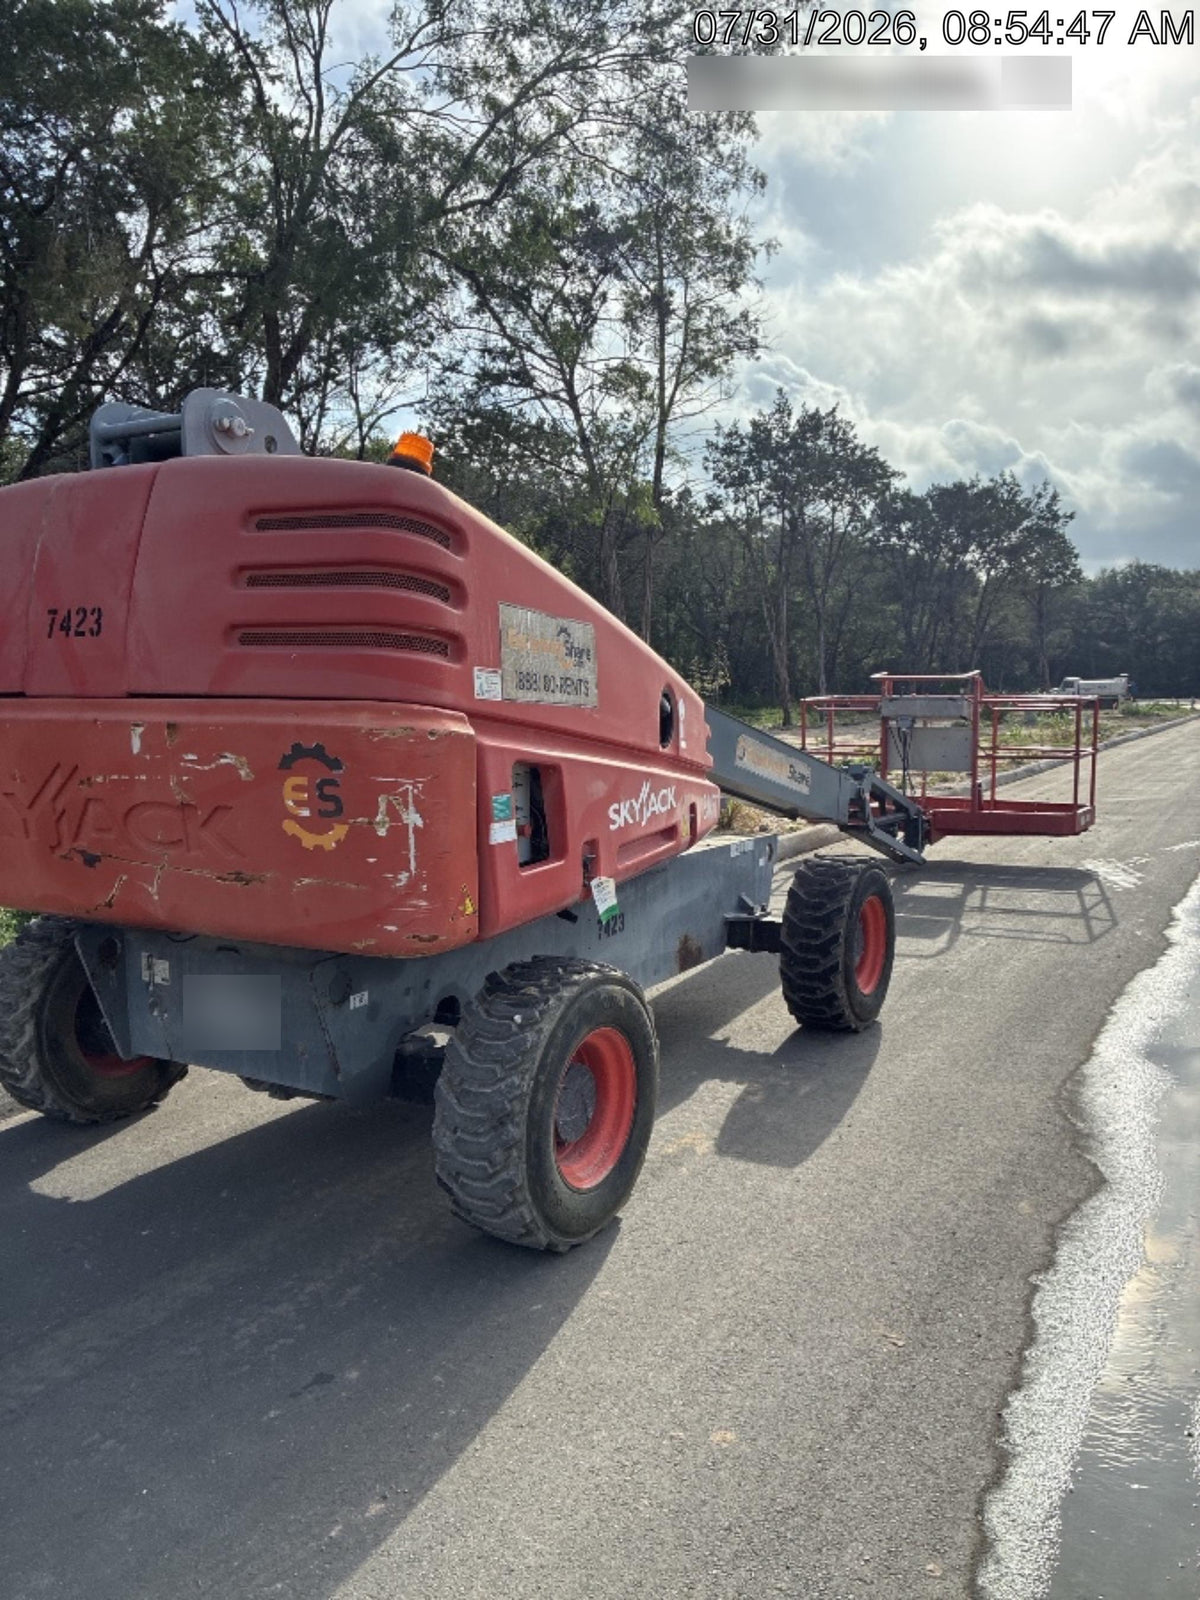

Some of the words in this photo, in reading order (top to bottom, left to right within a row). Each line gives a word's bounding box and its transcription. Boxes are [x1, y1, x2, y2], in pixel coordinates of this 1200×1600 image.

[46, 607, 103, 638] 7423
[283, 776, 344, 818] ES
[608, 779, 677, 830] SKYJACK
